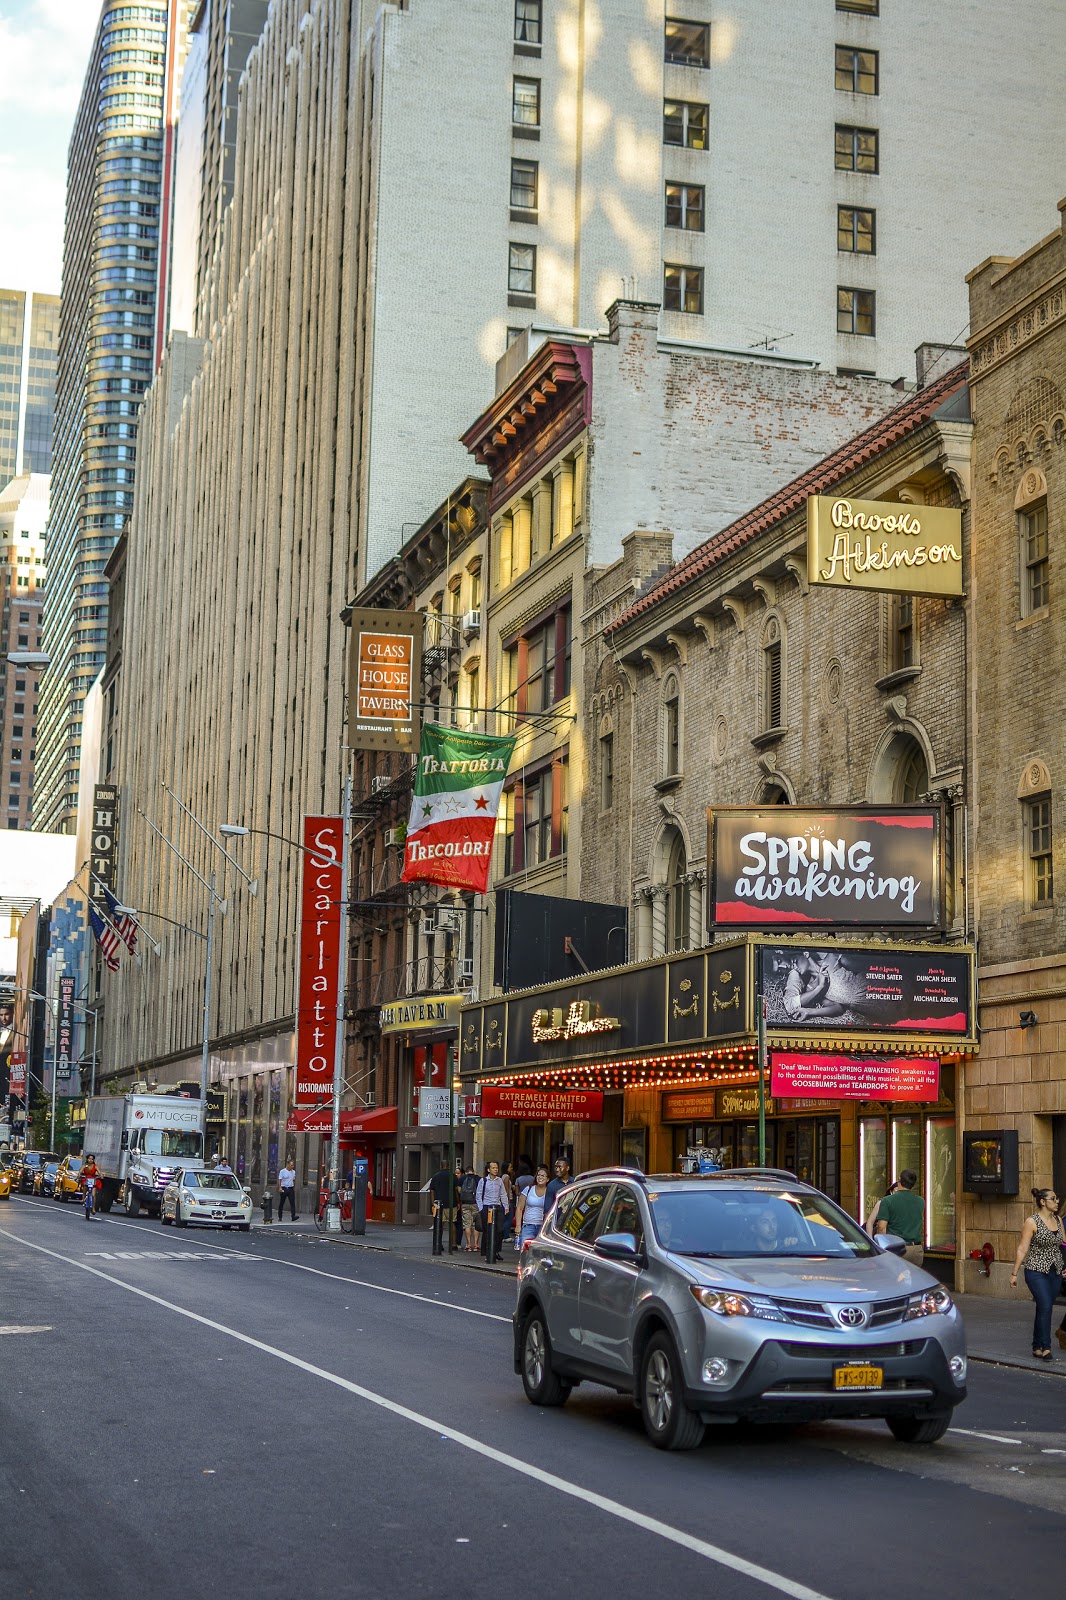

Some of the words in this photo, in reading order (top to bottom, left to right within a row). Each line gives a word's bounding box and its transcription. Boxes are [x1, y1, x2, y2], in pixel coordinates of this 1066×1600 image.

[832, 500, 920, 535] Brooks
[820, 532, 962, 581] Atkinson
[367, 643, 404, 658] GLASS
[362, 670, 408, 684] HOUSE
[360, 696, 409, 710] TAVERN
[96, 791, 114, 800] EDISON
[740, 832, 874, 876] SPRING
[734, 862, 922, 913] awakening
[309, 828, 337, 1072] Scarlatto
[62, 986, 72, 1018] DELI
[398, 1002, 447, 1023] TAVERN
[59, 1029, 70, 1069] SALAD
[298, 1082, 334, 1094] RISTORANTE
[500, 1093, 548, 1101] EXTREMELY
[512, 1101, 574, 1110] ENGAGEMENT!
[744, 1094, 773, 1113] awaking
[304, 1122, 333, 1131] Scarlatt
